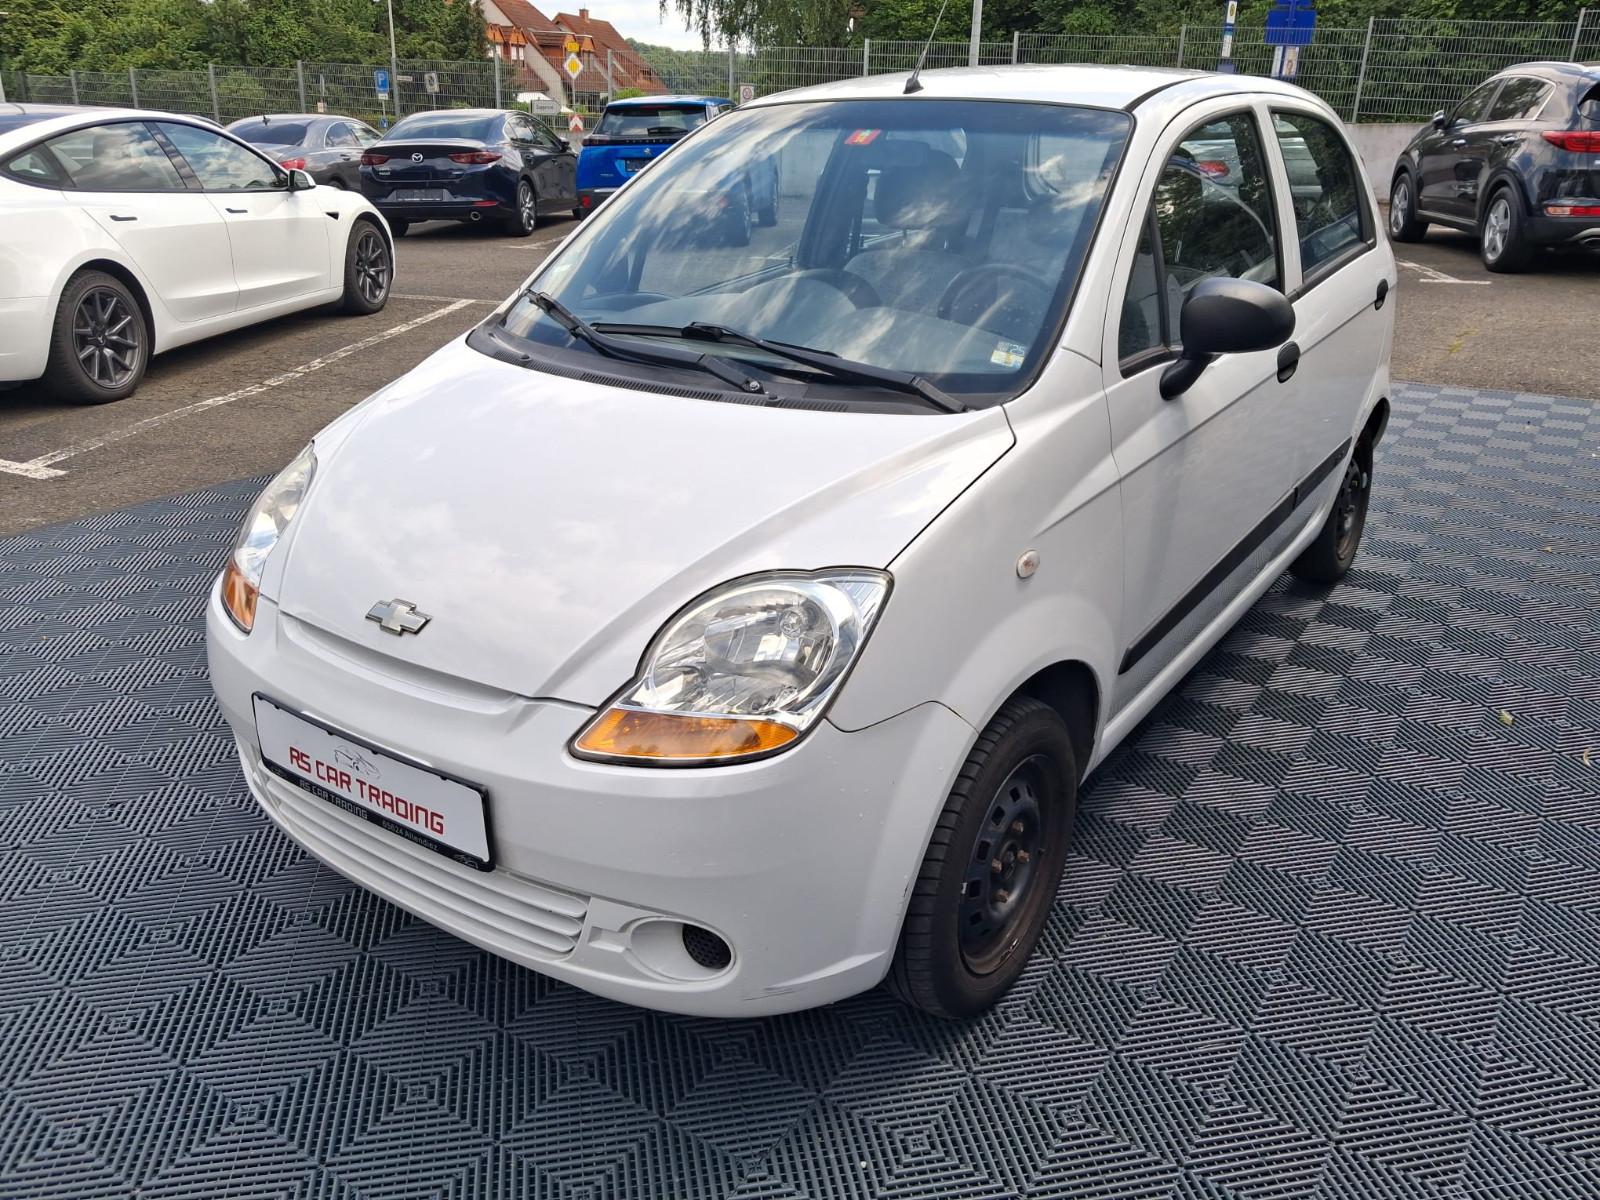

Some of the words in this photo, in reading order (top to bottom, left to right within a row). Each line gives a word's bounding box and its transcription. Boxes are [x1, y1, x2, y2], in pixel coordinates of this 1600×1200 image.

[377, 73, 385, 85] P
[289, 746, 311, 773] RS
[316, 759, 352, 793] CAR
[356, 778, 444, 835] TRADING
[312, 785, 329, 801] CAR
